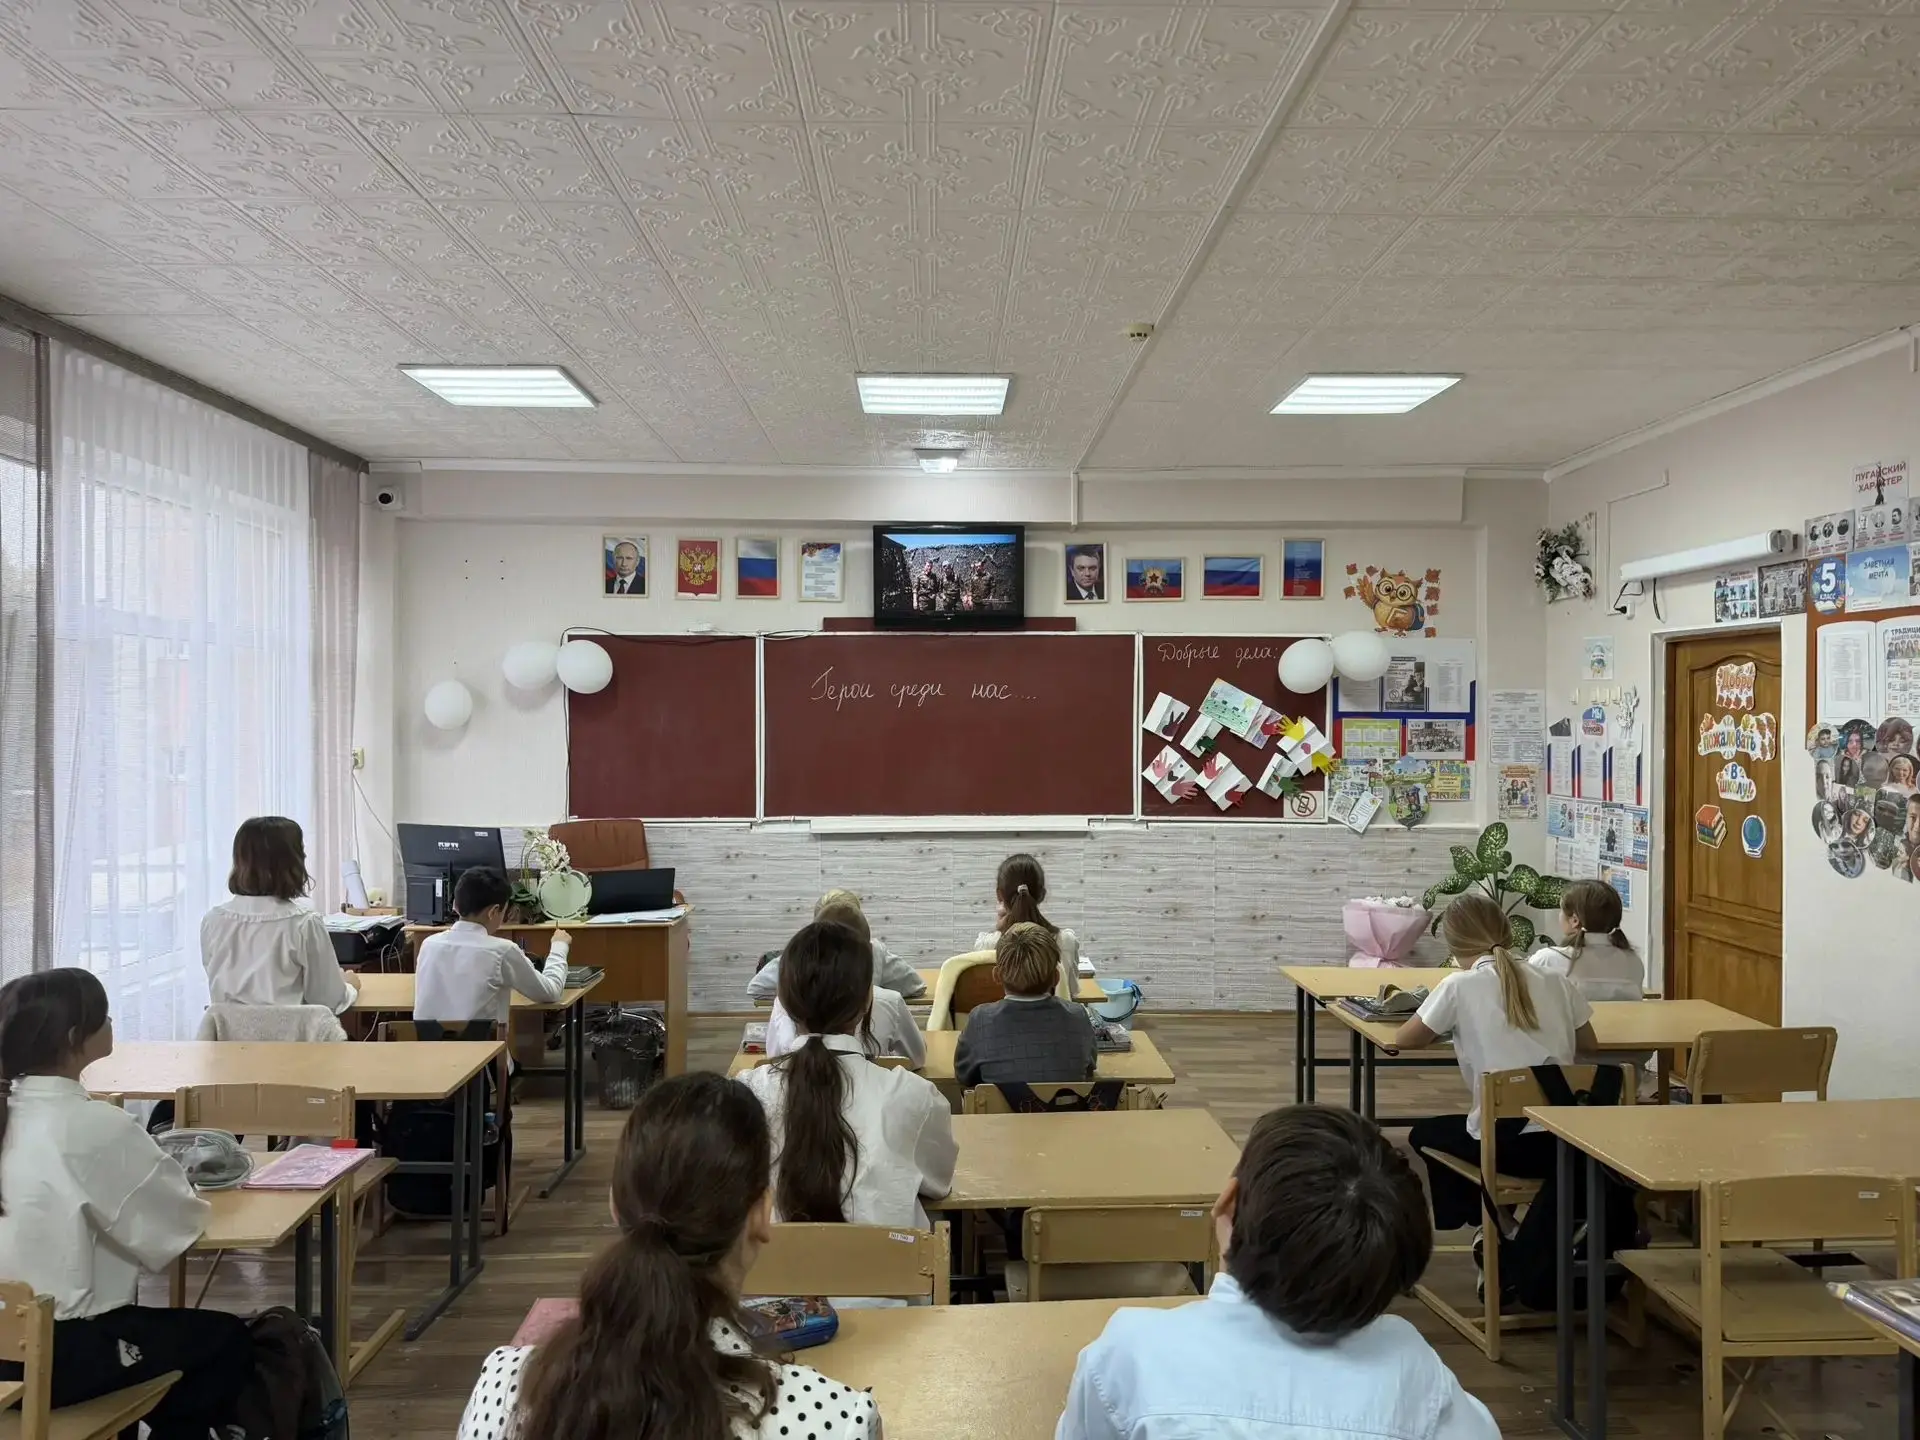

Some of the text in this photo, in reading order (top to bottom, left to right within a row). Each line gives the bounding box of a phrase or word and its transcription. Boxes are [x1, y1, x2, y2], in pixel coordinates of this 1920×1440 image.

[1863, 557, 1895, 570] ЗАВЕТНАЯ
[1868, 570, 1889, 580] МЕЧТА
[1820, 562, 1836, 593] 5
[1157, 642, 1220, 669] Добрые
[810, 666, 875, 711] Герои
[890, 682, 946, 708] среди
